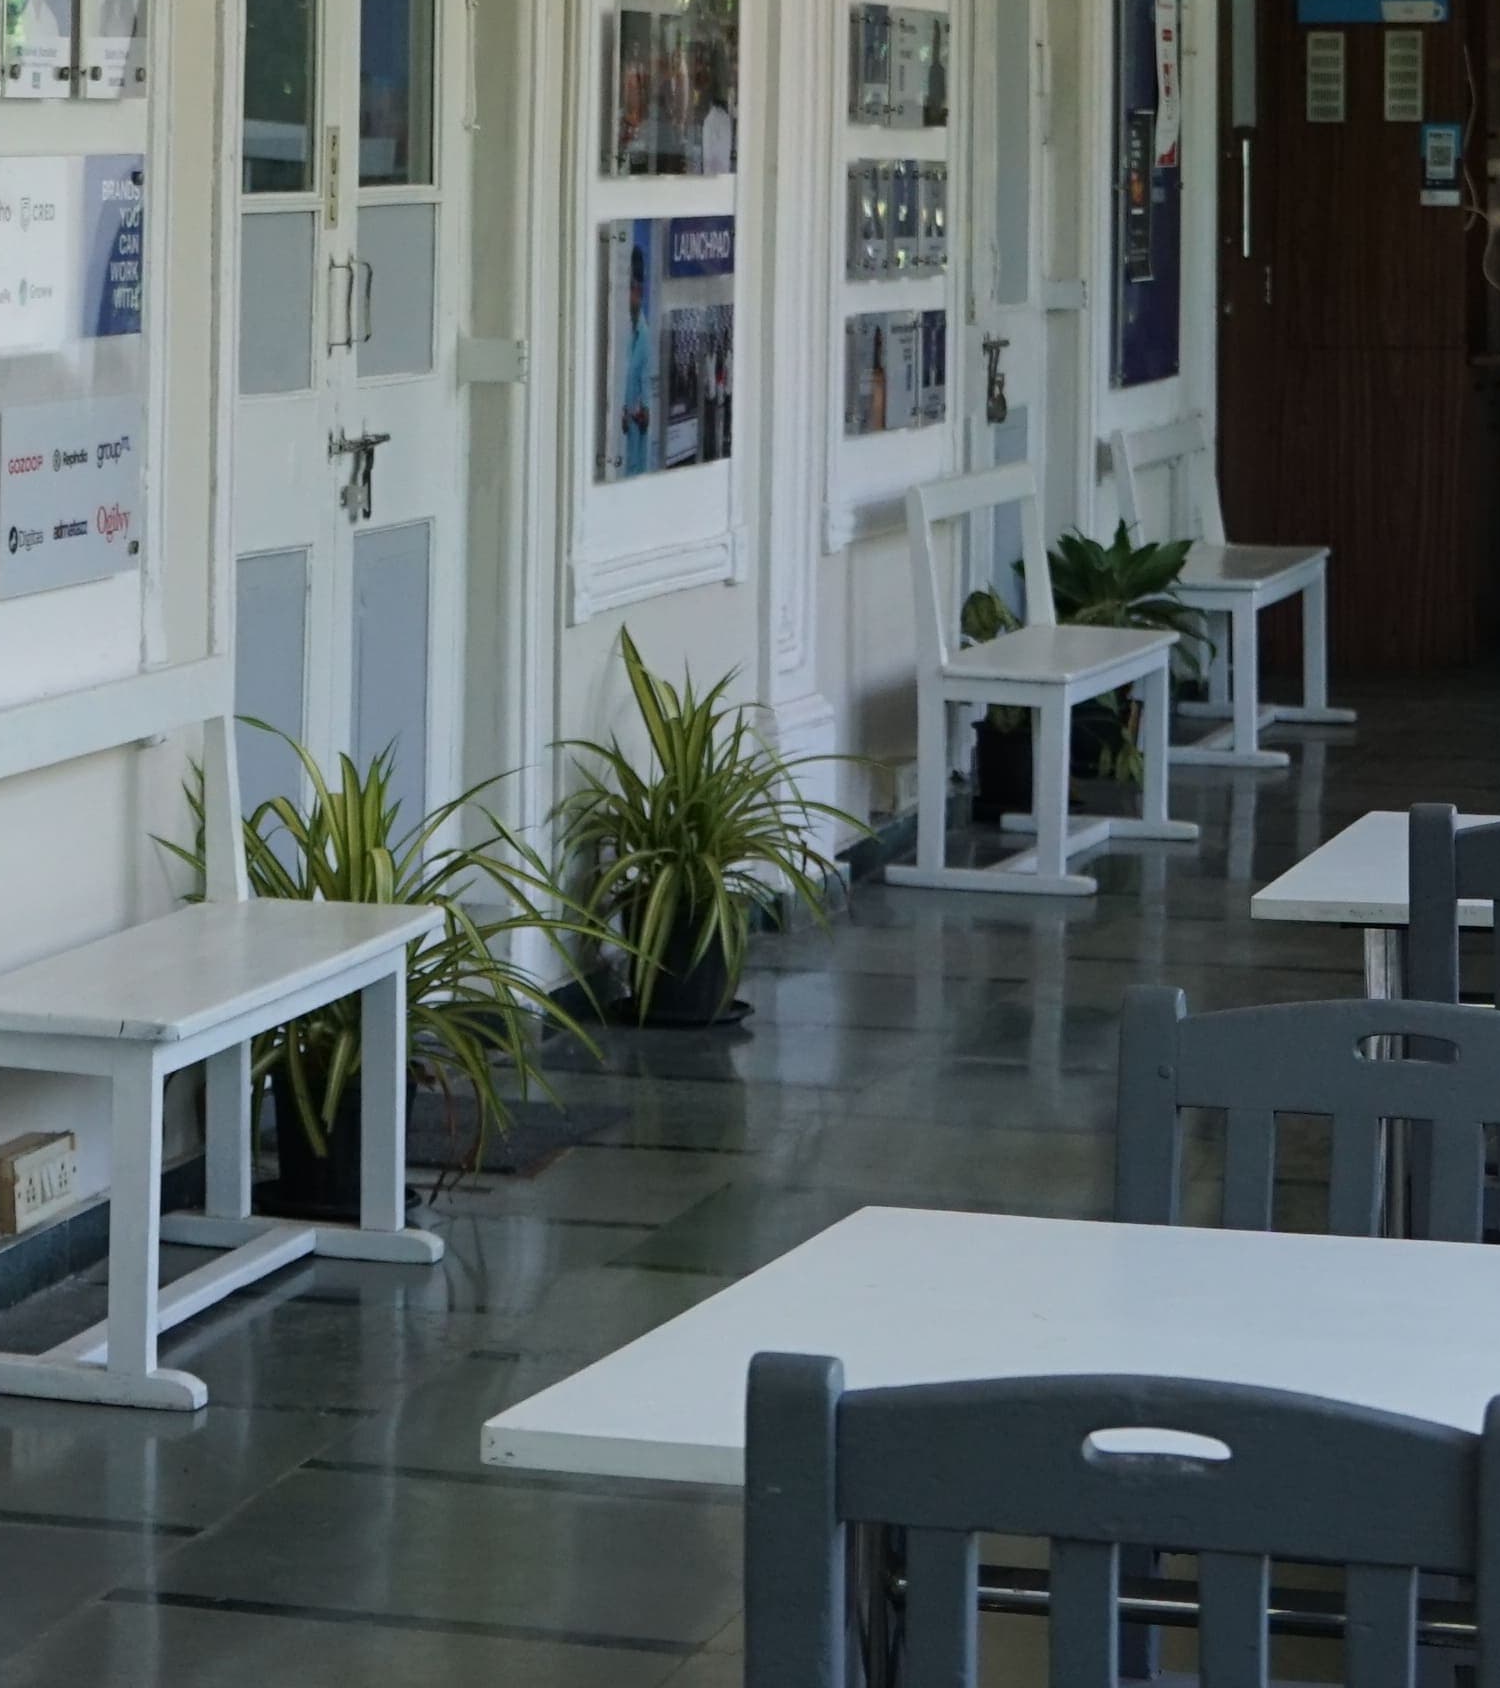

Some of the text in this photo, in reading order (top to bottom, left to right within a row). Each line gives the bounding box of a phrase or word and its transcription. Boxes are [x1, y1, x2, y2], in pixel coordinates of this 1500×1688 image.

[101, 180, 141, 201] BRANDS
[120, 206, 140, 228] YOU
[119, 233, 140, 255] CAN
[110, 261, 140, 282] WORK
